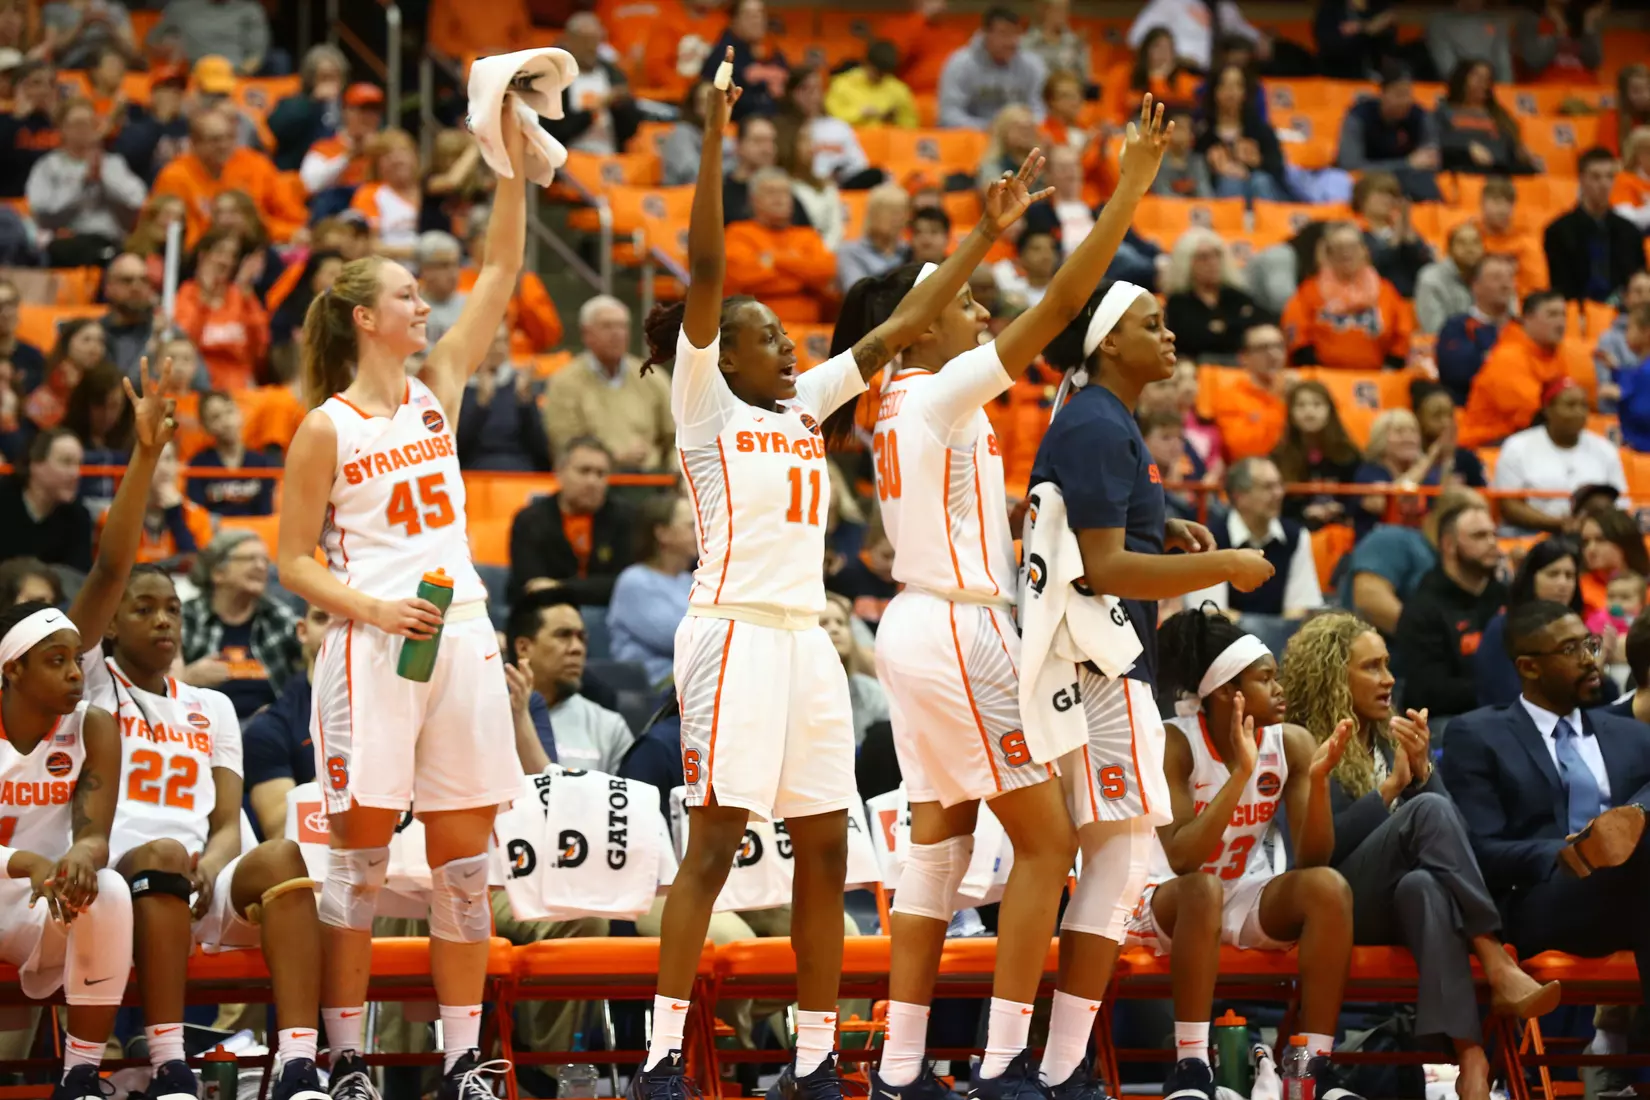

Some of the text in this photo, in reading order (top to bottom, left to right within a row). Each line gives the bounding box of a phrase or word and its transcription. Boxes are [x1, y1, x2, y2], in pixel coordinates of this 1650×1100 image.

[872, 428, 902, 502] 30
[385, 471, 456, 538] 45
[786, 466, 820, 526] 11
[684, 748, 701, 785] S
[1001, 730, 1031, 767] S
[127, 748, 199, 811] 22
[327, 755, 349, 791] S
[1099, 764, 1127, 801] S
